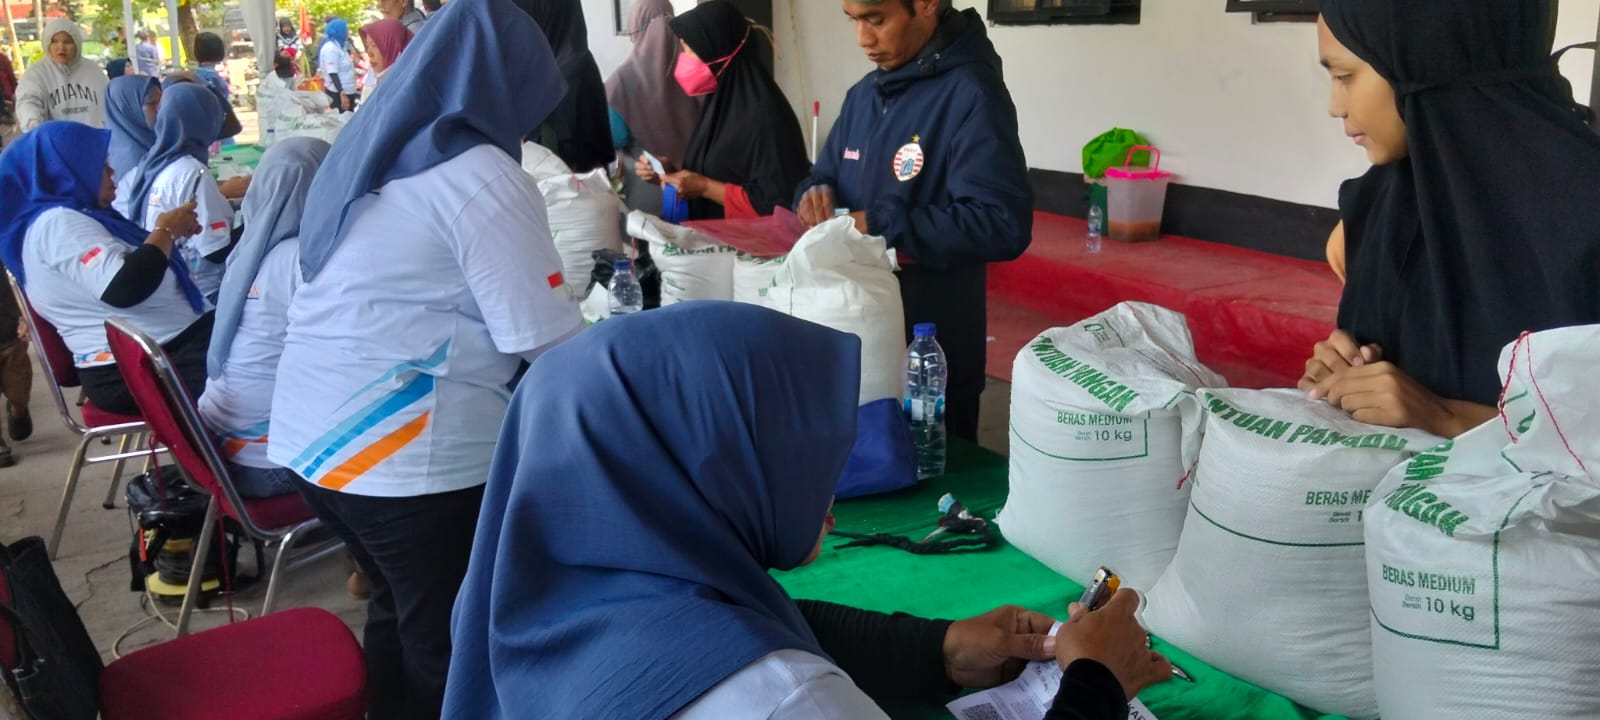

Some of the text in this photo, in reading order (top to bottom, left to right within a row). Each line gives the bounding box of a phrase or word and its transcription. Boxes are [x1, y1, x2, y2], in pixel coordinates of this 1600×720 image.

[49, 82, 98, 109] MIAMI
[1063, 364, 1140, 413] PANGAN
[1057, 411, 1086, 426] BERAS
[1094, 430, 1110, 441] 10
[1114, 429, 1132, 442] kg
[1305, 489, 1371, 505] BERAS ME
[1382, 564, 1475, 595] BERAS MEDIUM
[1426, 597, 1474, 621] 10 kg
